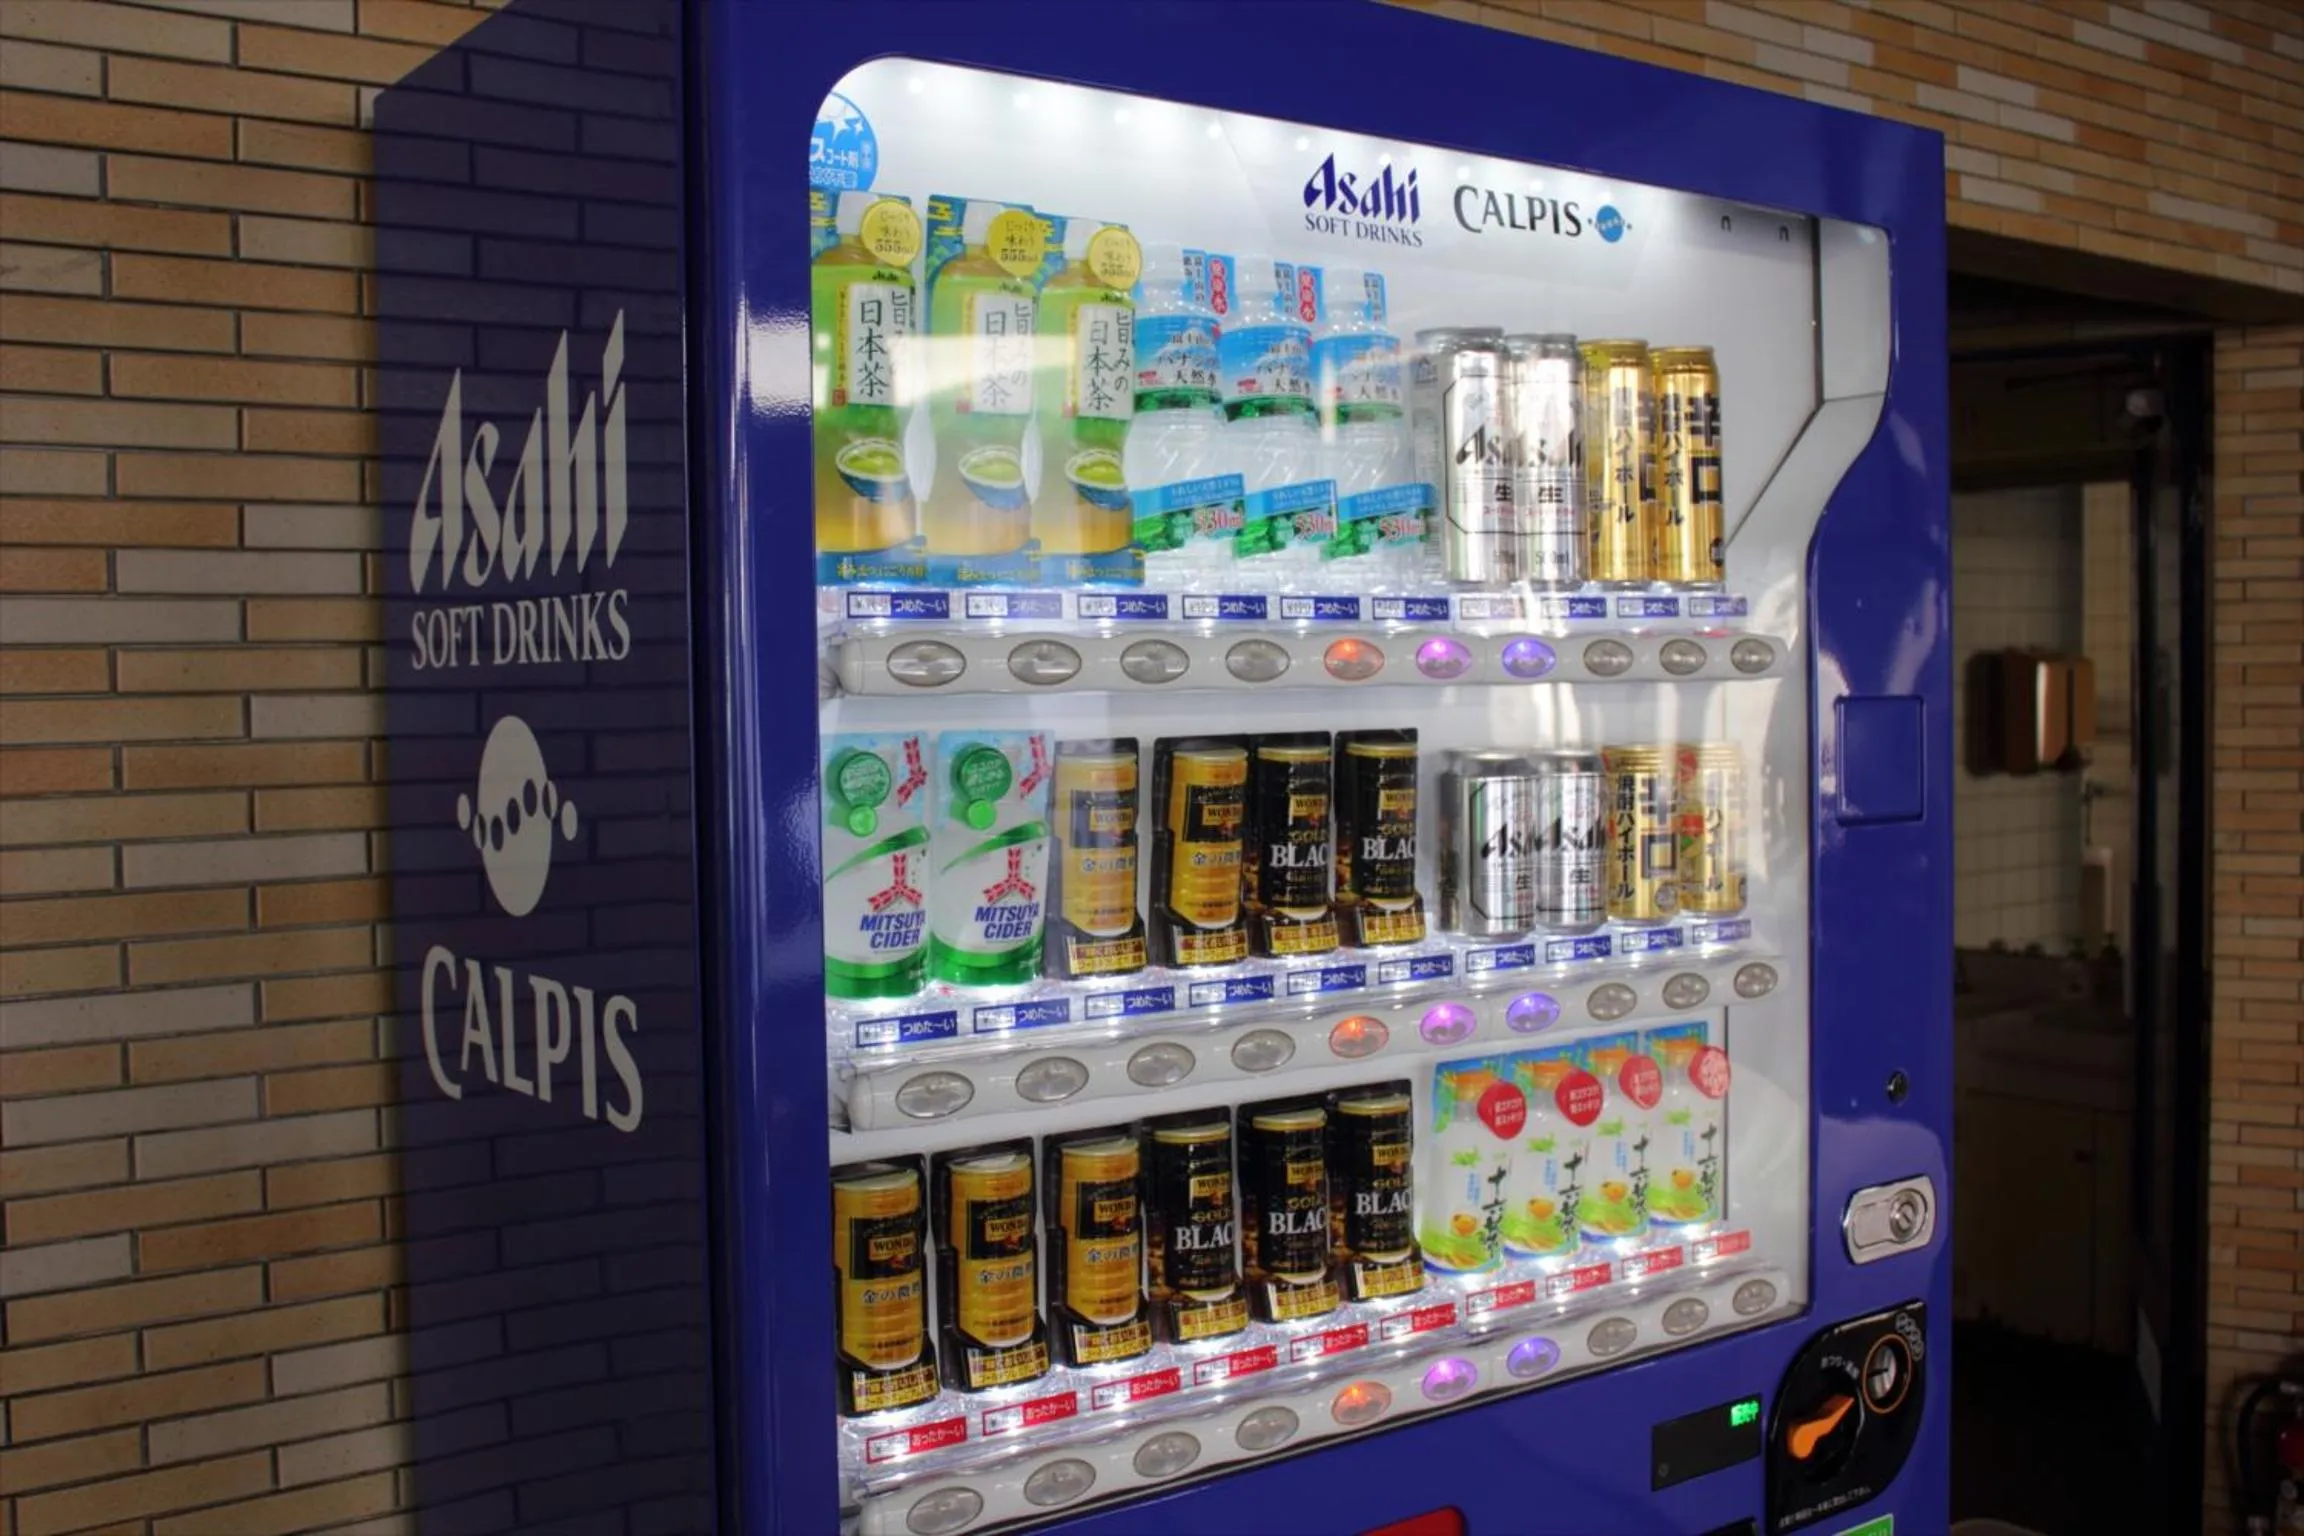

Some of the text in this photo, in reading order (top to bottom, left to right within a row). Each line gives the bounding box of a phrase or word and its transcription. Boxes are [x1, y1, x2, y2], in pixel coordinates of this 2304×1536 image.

[1303, 152, 1420, 224] Asahi
[1453, 185, 1582, 237] CALPIS
[1305, 213, 1423, 248] SOFT DRINKS
[857, 299, 891, 399] 日本茶
[1085, 319, 1115, 411] 日本茶
[1113, 309, 1132, 394] 旨みの
[409, 308, 627, 593] Asahi
[1538, 484, 1564, 504] 生
[412, 588, 631, 670] SOFT DRINKS
[1570, 868, 1592, 885] 生
[870, 928, 920, 950] CIDER
[984, 920, 1033, 940] CIDER
[421, 943, 644, 1134] CALPIS
